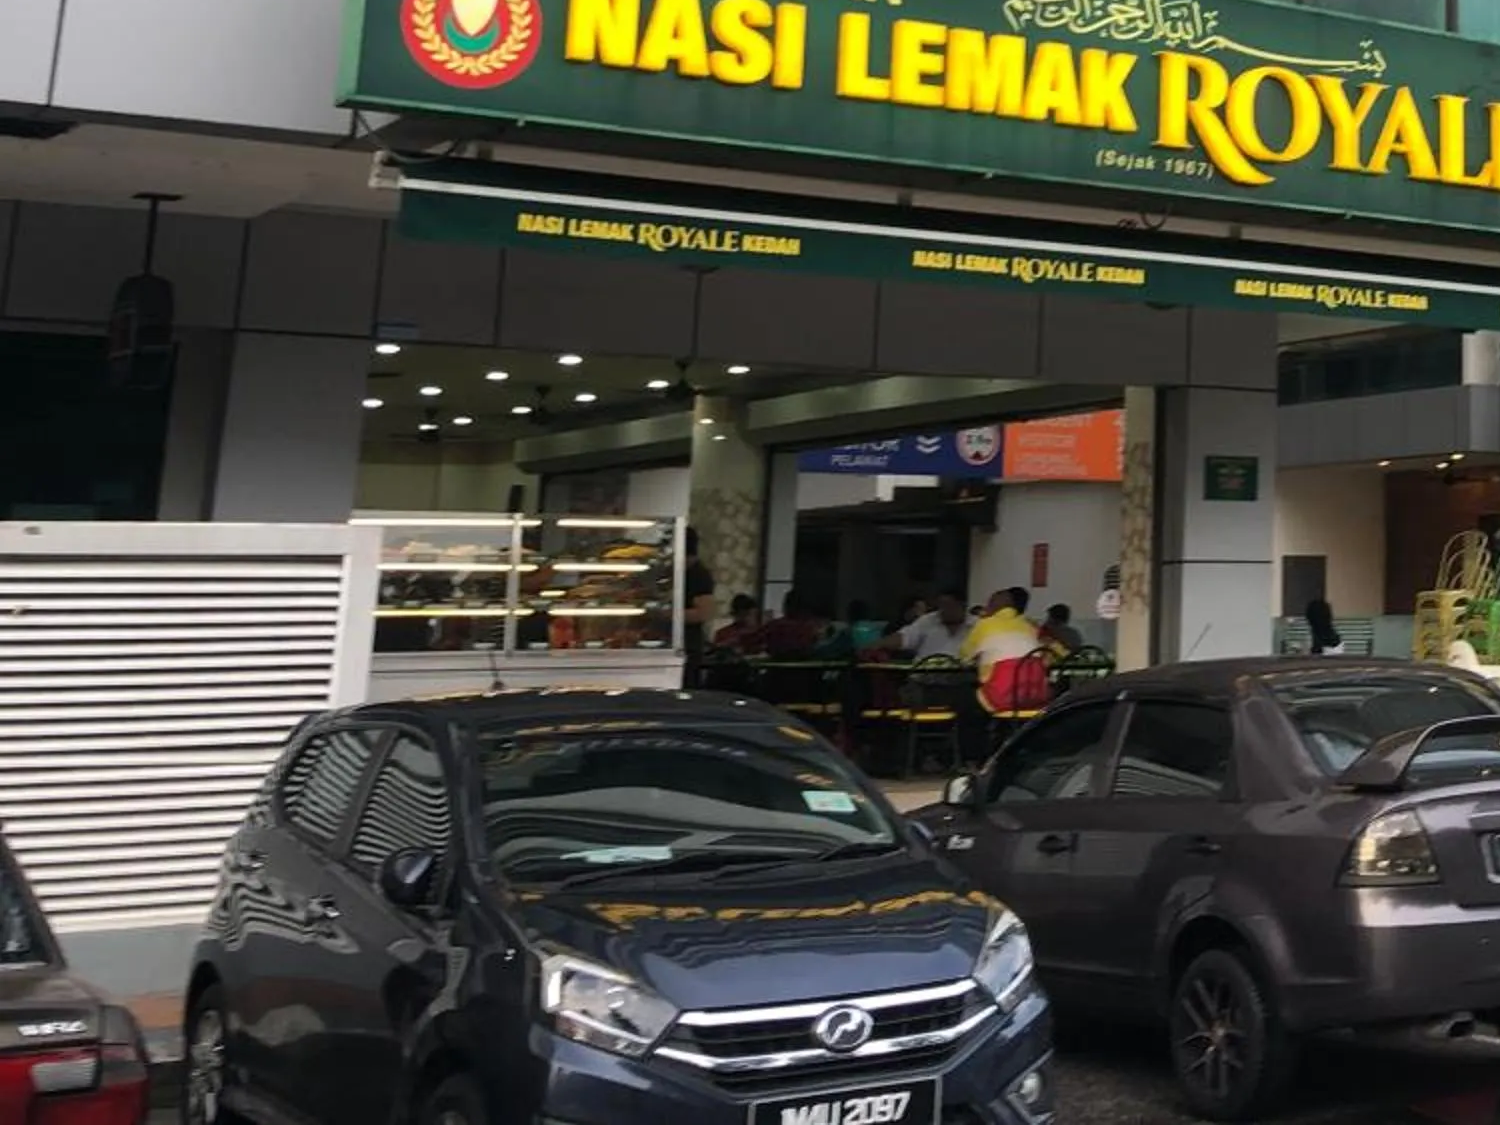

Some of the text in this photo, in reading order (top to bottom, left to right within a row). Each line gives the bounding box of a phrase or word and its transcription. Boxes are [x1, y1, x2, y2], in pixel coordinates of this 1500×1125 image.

[836, 11, 1137, 133] LEMAK
[517, 213, 800, 256] NASI LEMAK ROYALE KEDAH
[912, 250, 952, 269] NASI
[955, 253, 1008, 274] LEMAK
[1010, 255, 1096, 283] ROYALE
[1315, 284, 1387, 309] ROYALE
[842, 1091, 911, 1125] 2097
